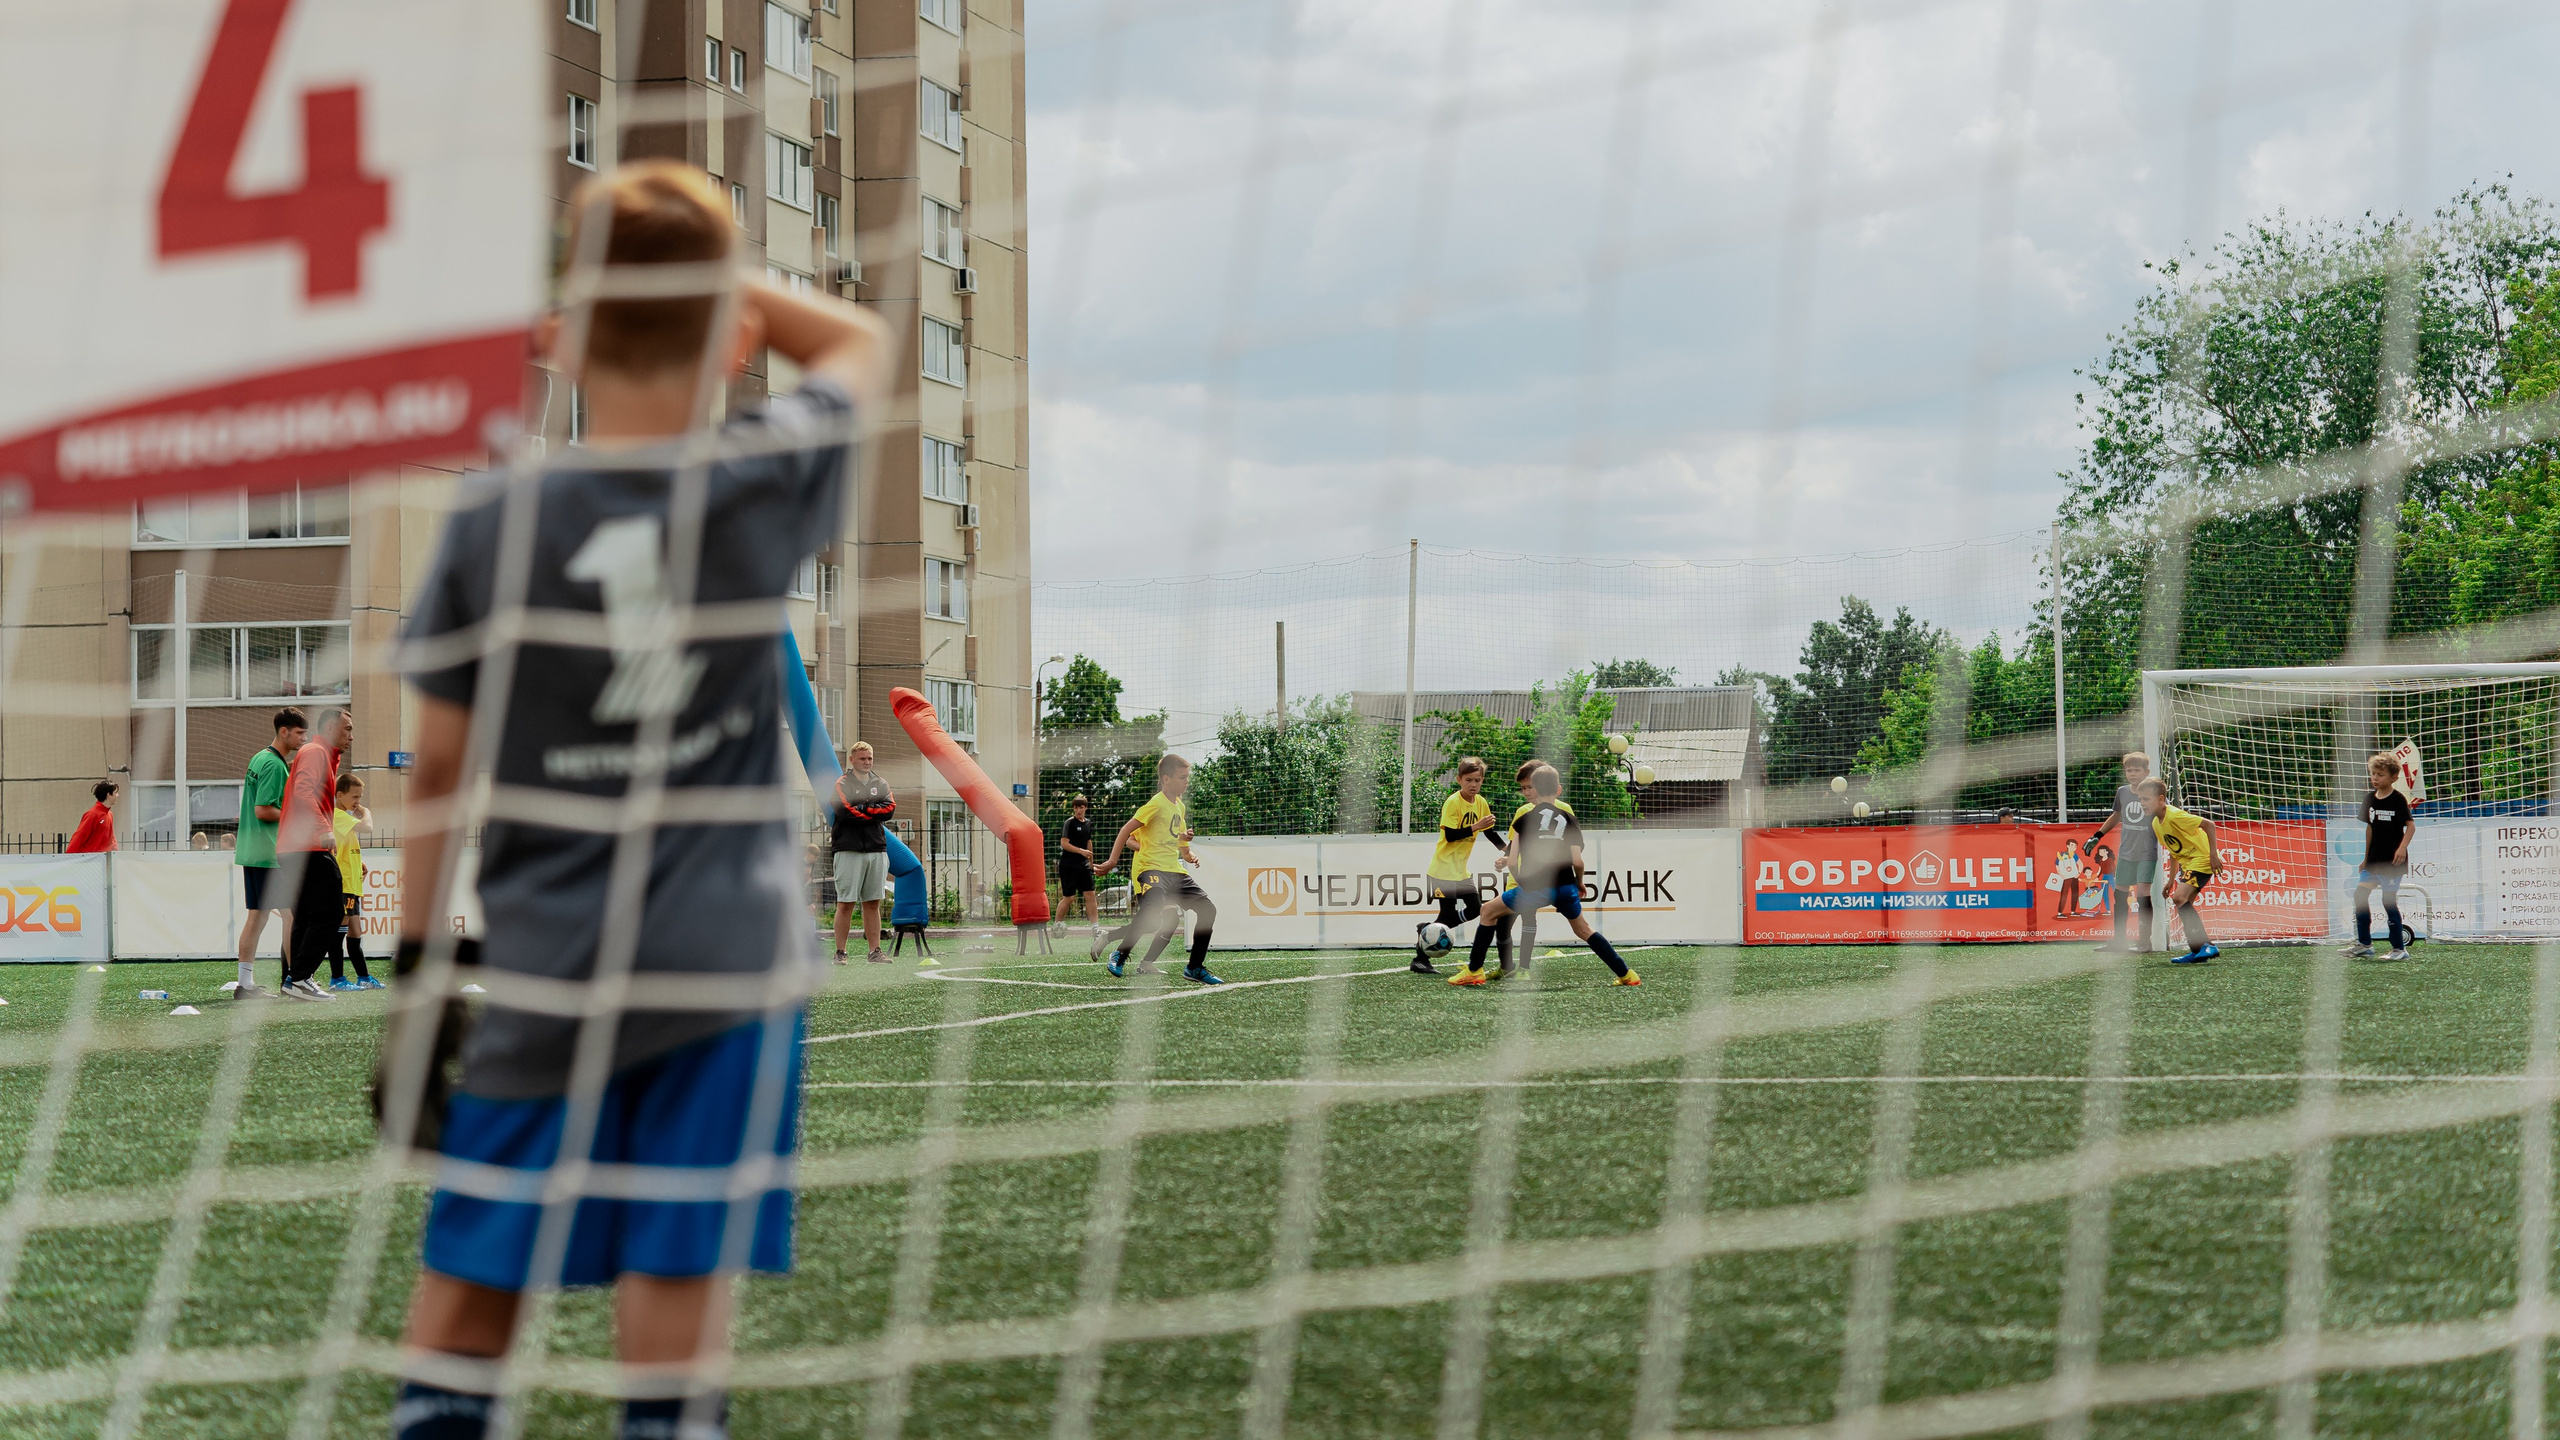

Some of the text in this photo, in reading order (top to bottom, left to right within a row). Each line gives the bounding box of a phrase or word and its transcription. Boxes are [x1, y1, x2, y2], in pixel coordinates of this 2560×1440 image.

[154, 0, 392, 302] 4
[1539, 808, 1567, 839] 11
[1149, 875, 1159, 883] 19
[346, 897, 355, 909] 18
[1800, 893, 1989, 908] МАГАЗИН НИЗКИХ ЦЕН
[2248, 890, 2317, 905] ХИМИЯ
[1754, 931, 1775, 939] ООО
[1866, 930, 1889, 938] ОГРН
